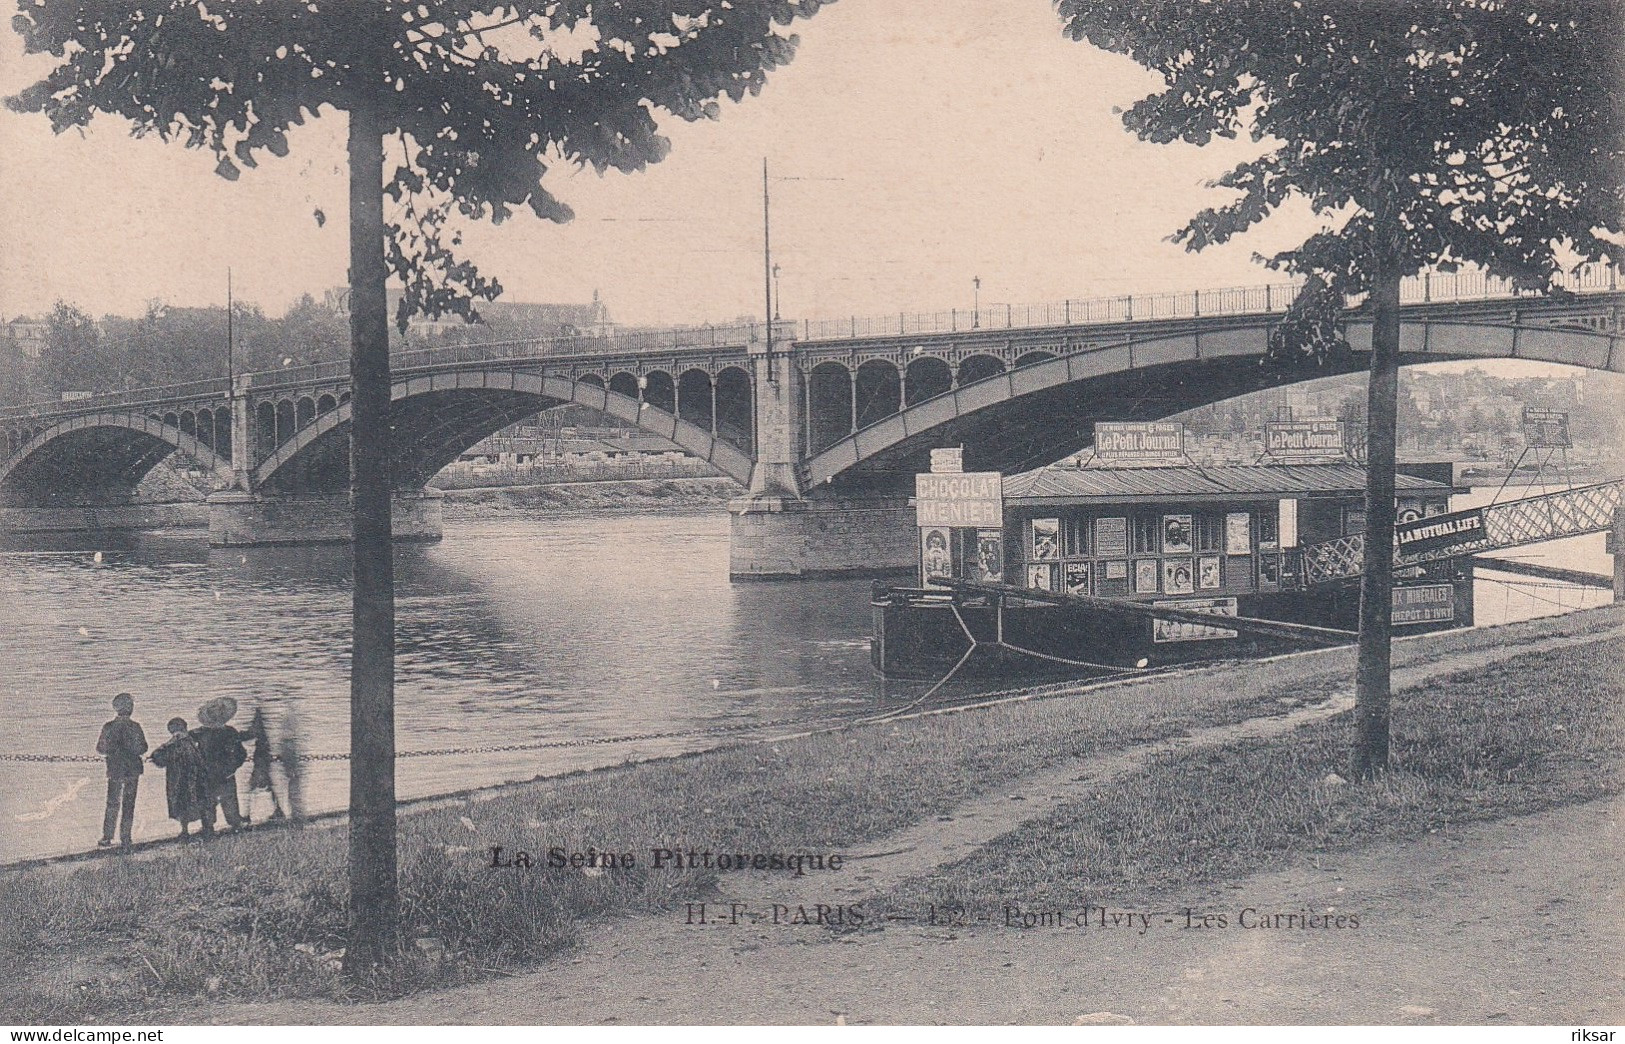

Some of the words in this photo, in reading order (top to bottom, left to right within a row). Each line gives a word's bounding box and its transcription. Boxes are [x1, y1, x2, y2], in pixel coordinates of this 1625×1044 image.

[1098, 432, 1112, 450] Le
[1112, 432, 1138, 450] Petit
[1139, 432, 1180, 450] Journal
[1269, 431, 1280, 448] Le
[1281, 431, 1304, 448] Petit
[1304, 431, 1342, 448] Journal
[919, 478, 998, 498] CHOCOLAT
[922, 502, 995, 522] MENIER
[1455, 516, 1481, 532] LIFE
